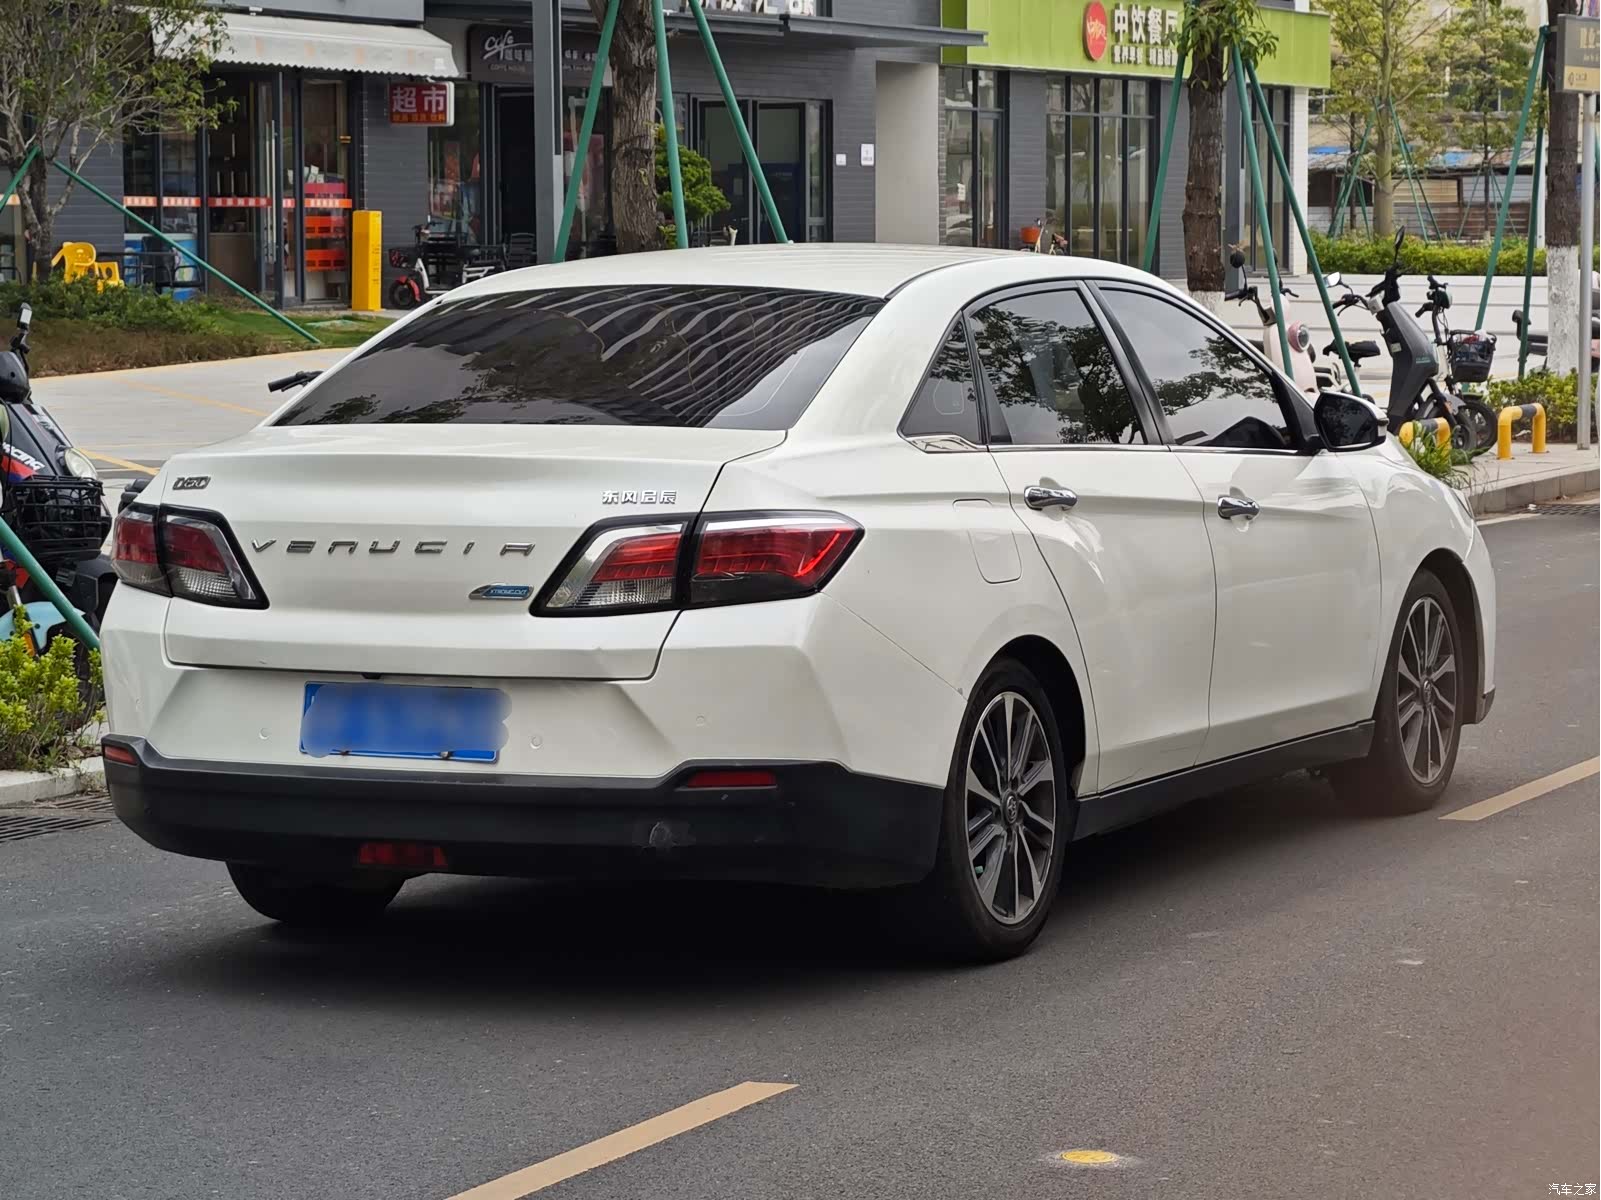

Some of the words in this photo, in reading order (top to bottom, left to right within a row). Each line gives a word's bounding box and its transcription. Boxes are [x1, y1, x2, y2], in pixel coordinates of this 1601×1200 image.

[392, 86, 446, 113] 超市
[602, 490, 677, 504] 东风启辰
[251, 539, 536, 557] VENUCIA
